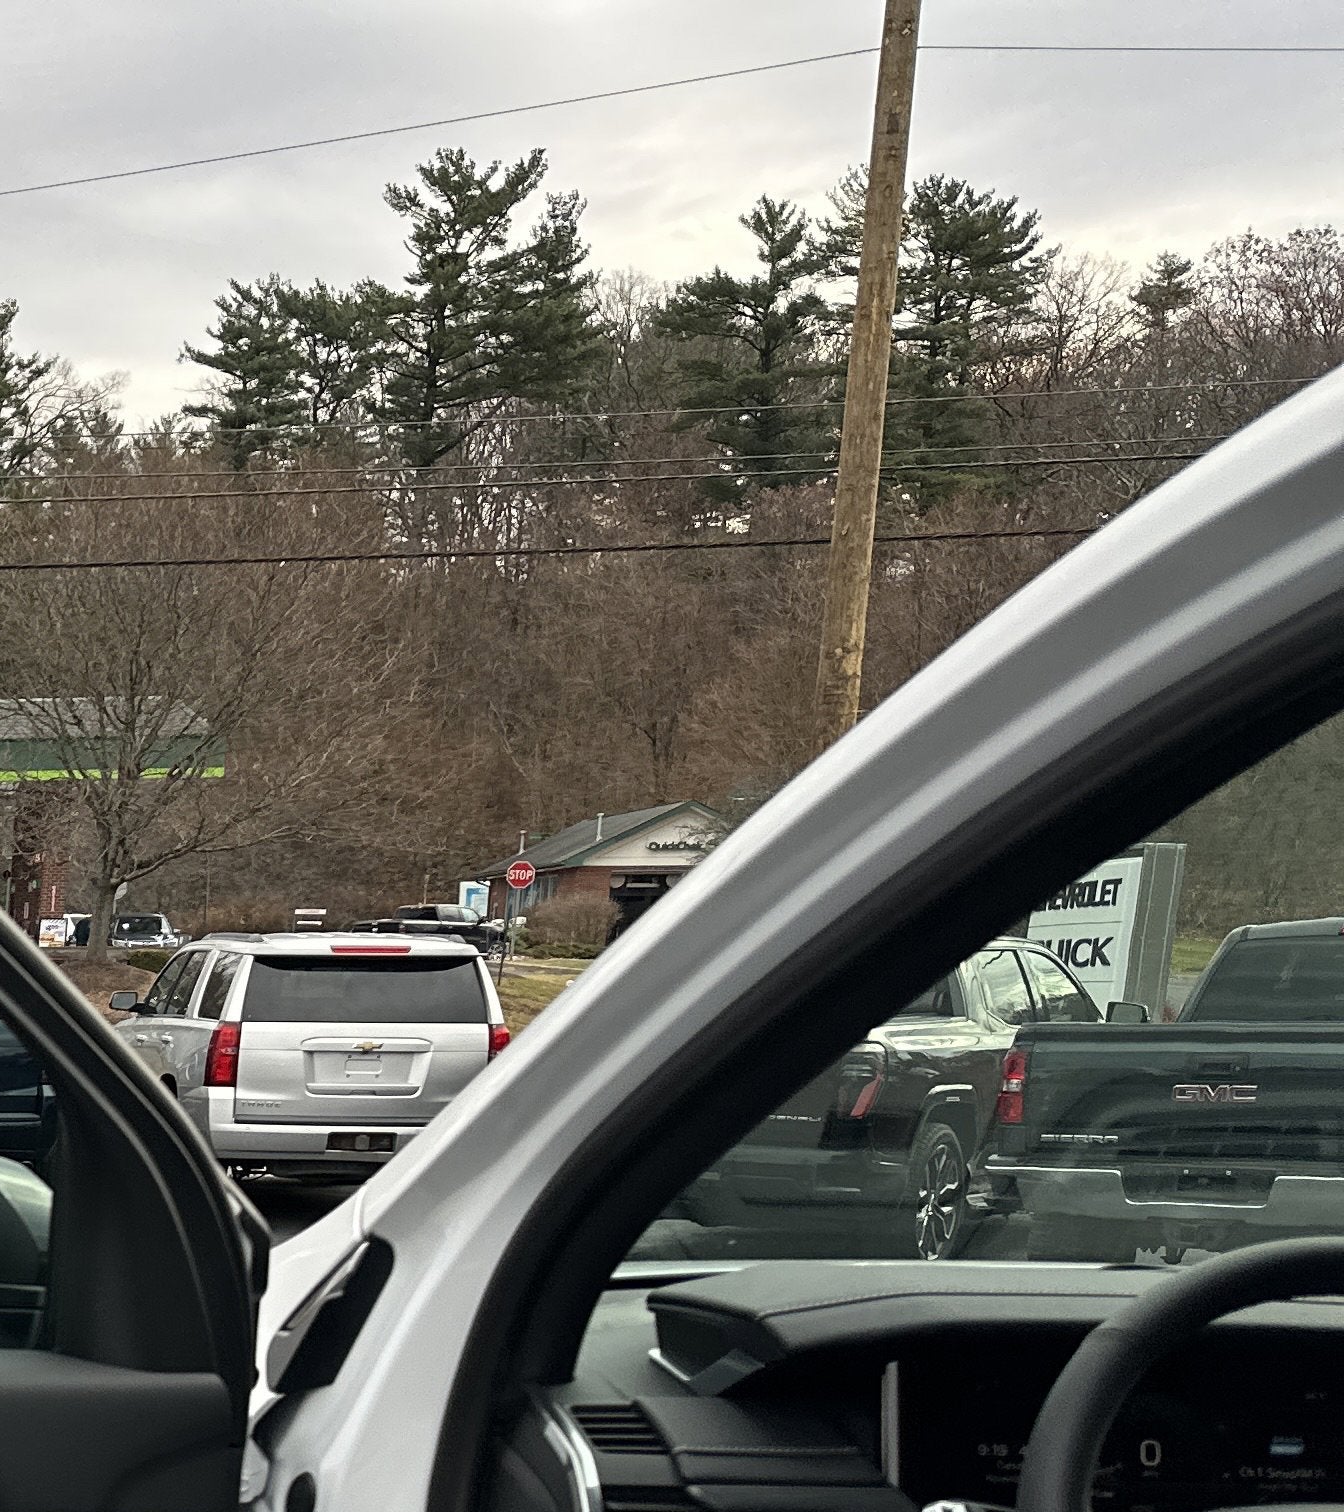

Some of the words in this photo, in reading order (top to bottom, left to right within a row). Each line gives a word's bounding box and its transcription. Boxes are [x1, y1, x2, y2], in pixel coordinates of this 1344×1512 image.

[508, 869, 533, 880] STOP
[1041, 878, 1123, 911] EVROLET
[1038, 937, 1114, 968] UICK
[1173, 1084, 1258, 1103] GMC
[1040, 1134, 1119, 1144] SIERRA
